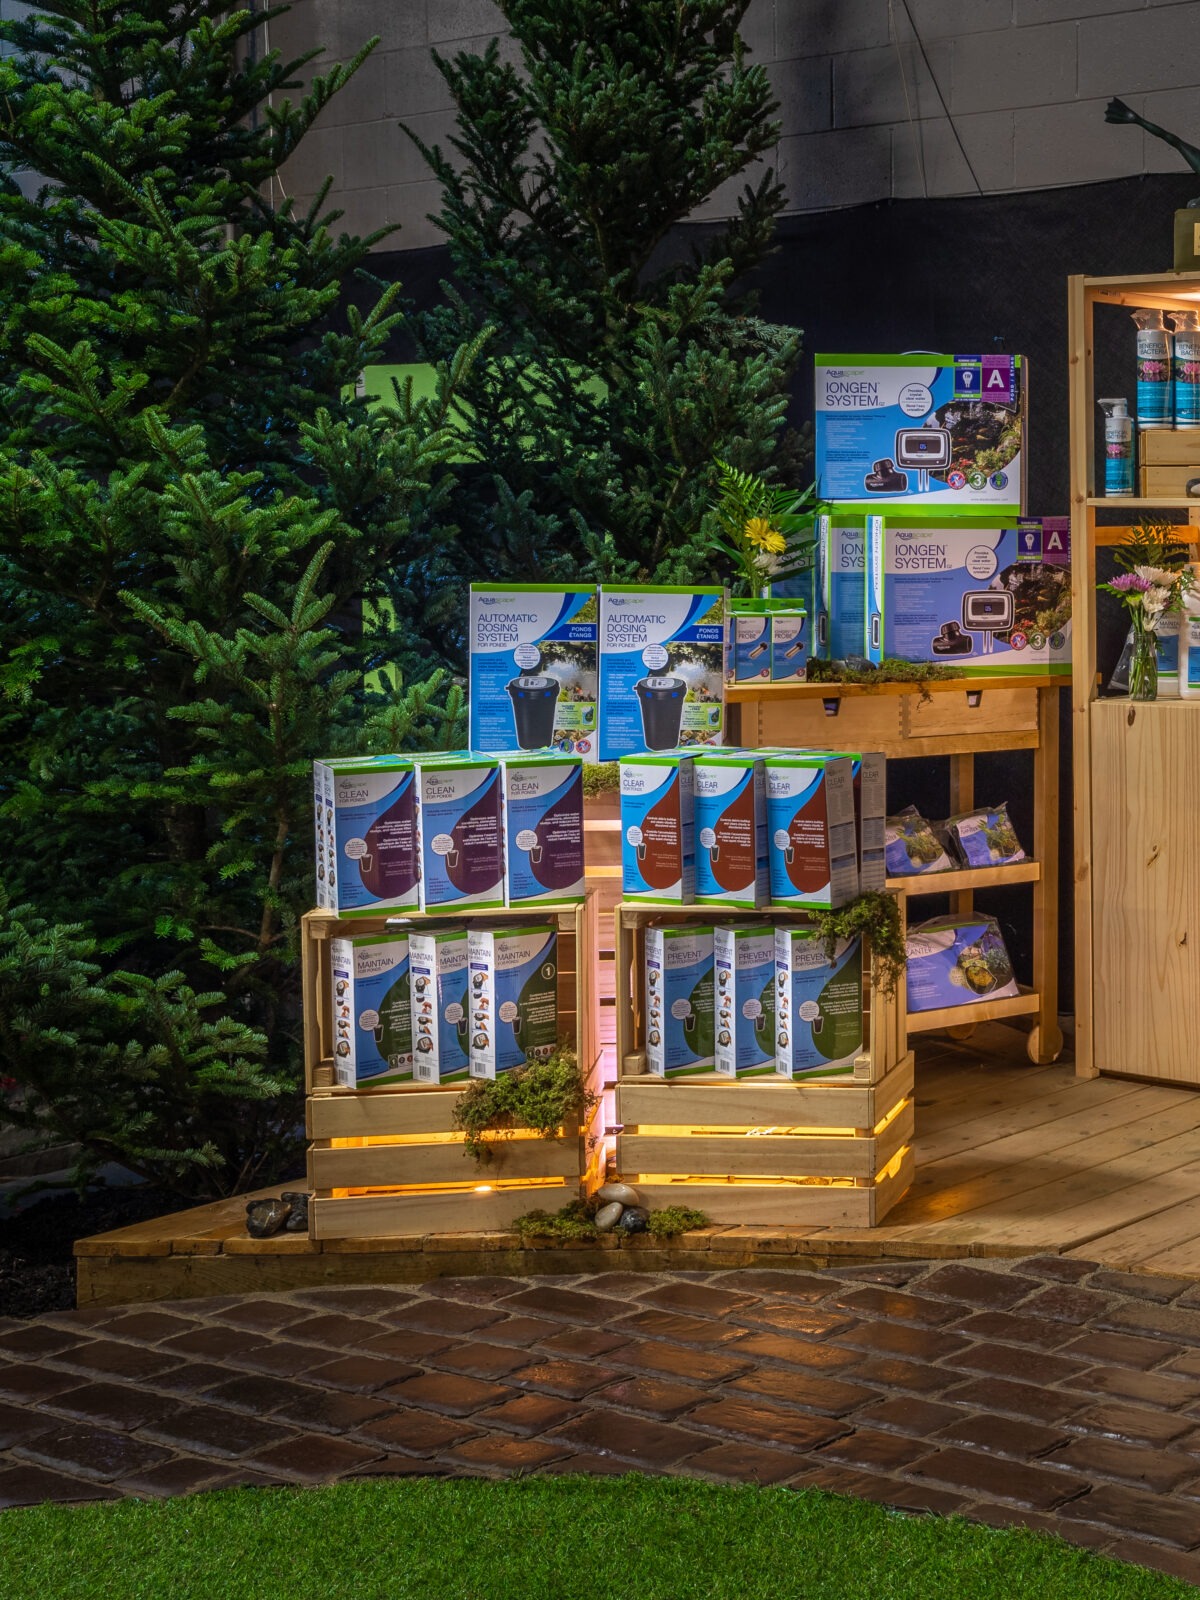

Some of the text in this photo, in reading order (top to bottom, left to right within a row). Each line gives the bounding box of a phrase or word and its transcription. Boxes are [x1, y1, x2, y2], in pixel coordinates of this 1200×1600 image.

[987, 369, 1004, 388] A
[826, 382, 878, 394] IONGEN
[826, 394, 878, 406] SYSTEM
[974, 475, 981, 486] 3
[1048, 532, 1062, 549] A
[841, 544, 864, 555] ION
[895, 544, 945, 556] IONGEN
[894, 557, 946, 568] SYSTEM
[478, 614, 537, 623] AUTOMATIC
[608, 615, 666, 624] AUTOMATIC
[478, 624, 518, 632] DOSING
[607, 624, 646, 633] DOSING
[478, 633, 518, 642] SYSTEM
[607, 634, 647, 642] SYSTEM
[1034, 635, 1041, 647] 3
[426, 786, 454, 794] CLEAN
[511, 782, 539, 790] CLEAN
[339, 790, 368, 798] CLEAN
[498, 950, 530, 960] MAINTAIN
[668, 951, 702, 960] PREVENT
[739, 950, 773, 959] PREVENT
[796, 953, 825, 962] PREVEN
[358, 959, 393, 969] MAINTAIN
[440, 954, 468, 965] MAINTAI
